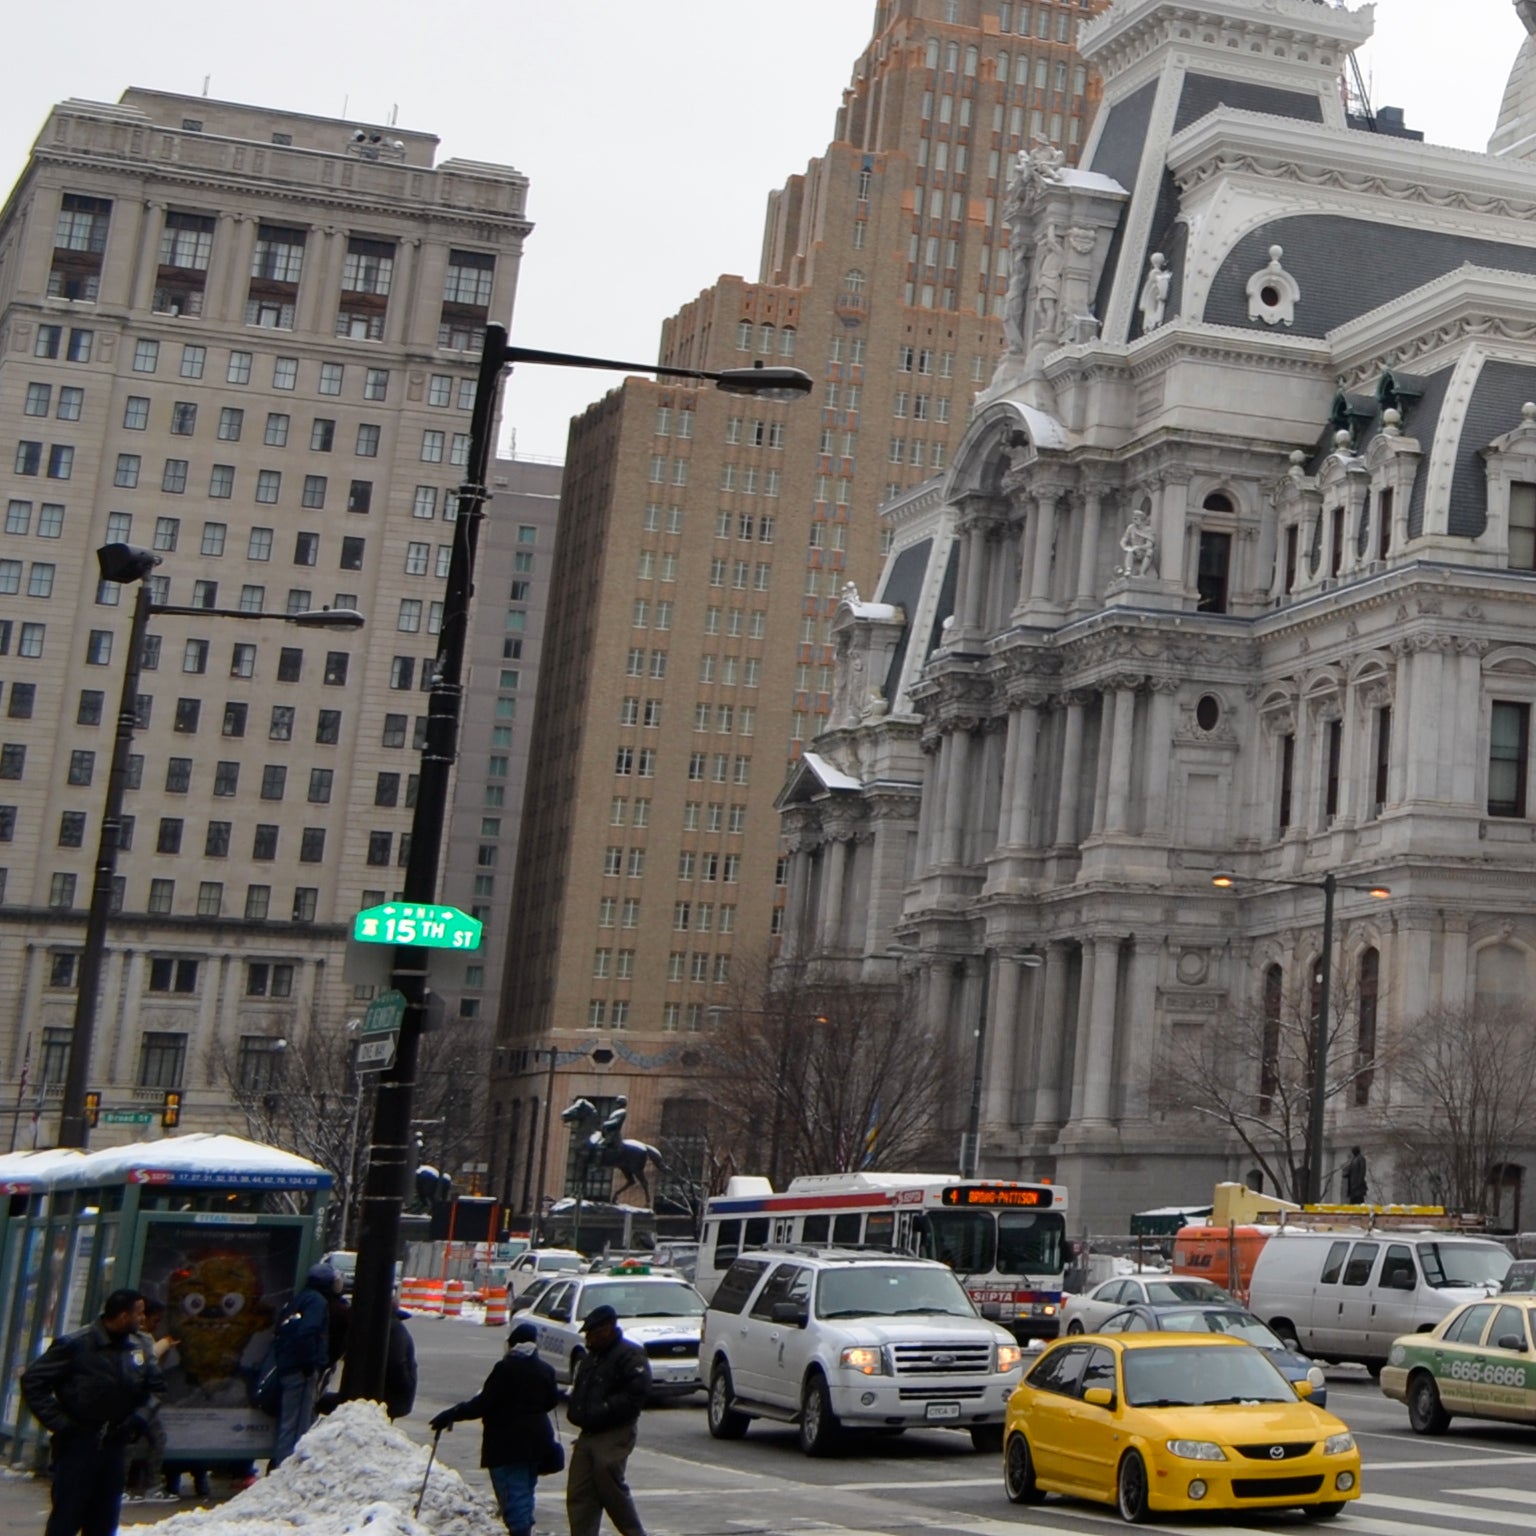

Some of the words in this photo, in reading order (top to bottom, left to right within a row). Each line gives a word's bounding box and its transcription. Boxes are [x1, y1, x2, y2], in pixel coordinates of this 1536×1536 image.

[453, 931, 474, 948] ST
[107, 1114, 135, 1124] Broad
[949, 1190, 958, 1205] 4
[973, 1292, 1014, 1302] SEPTA
